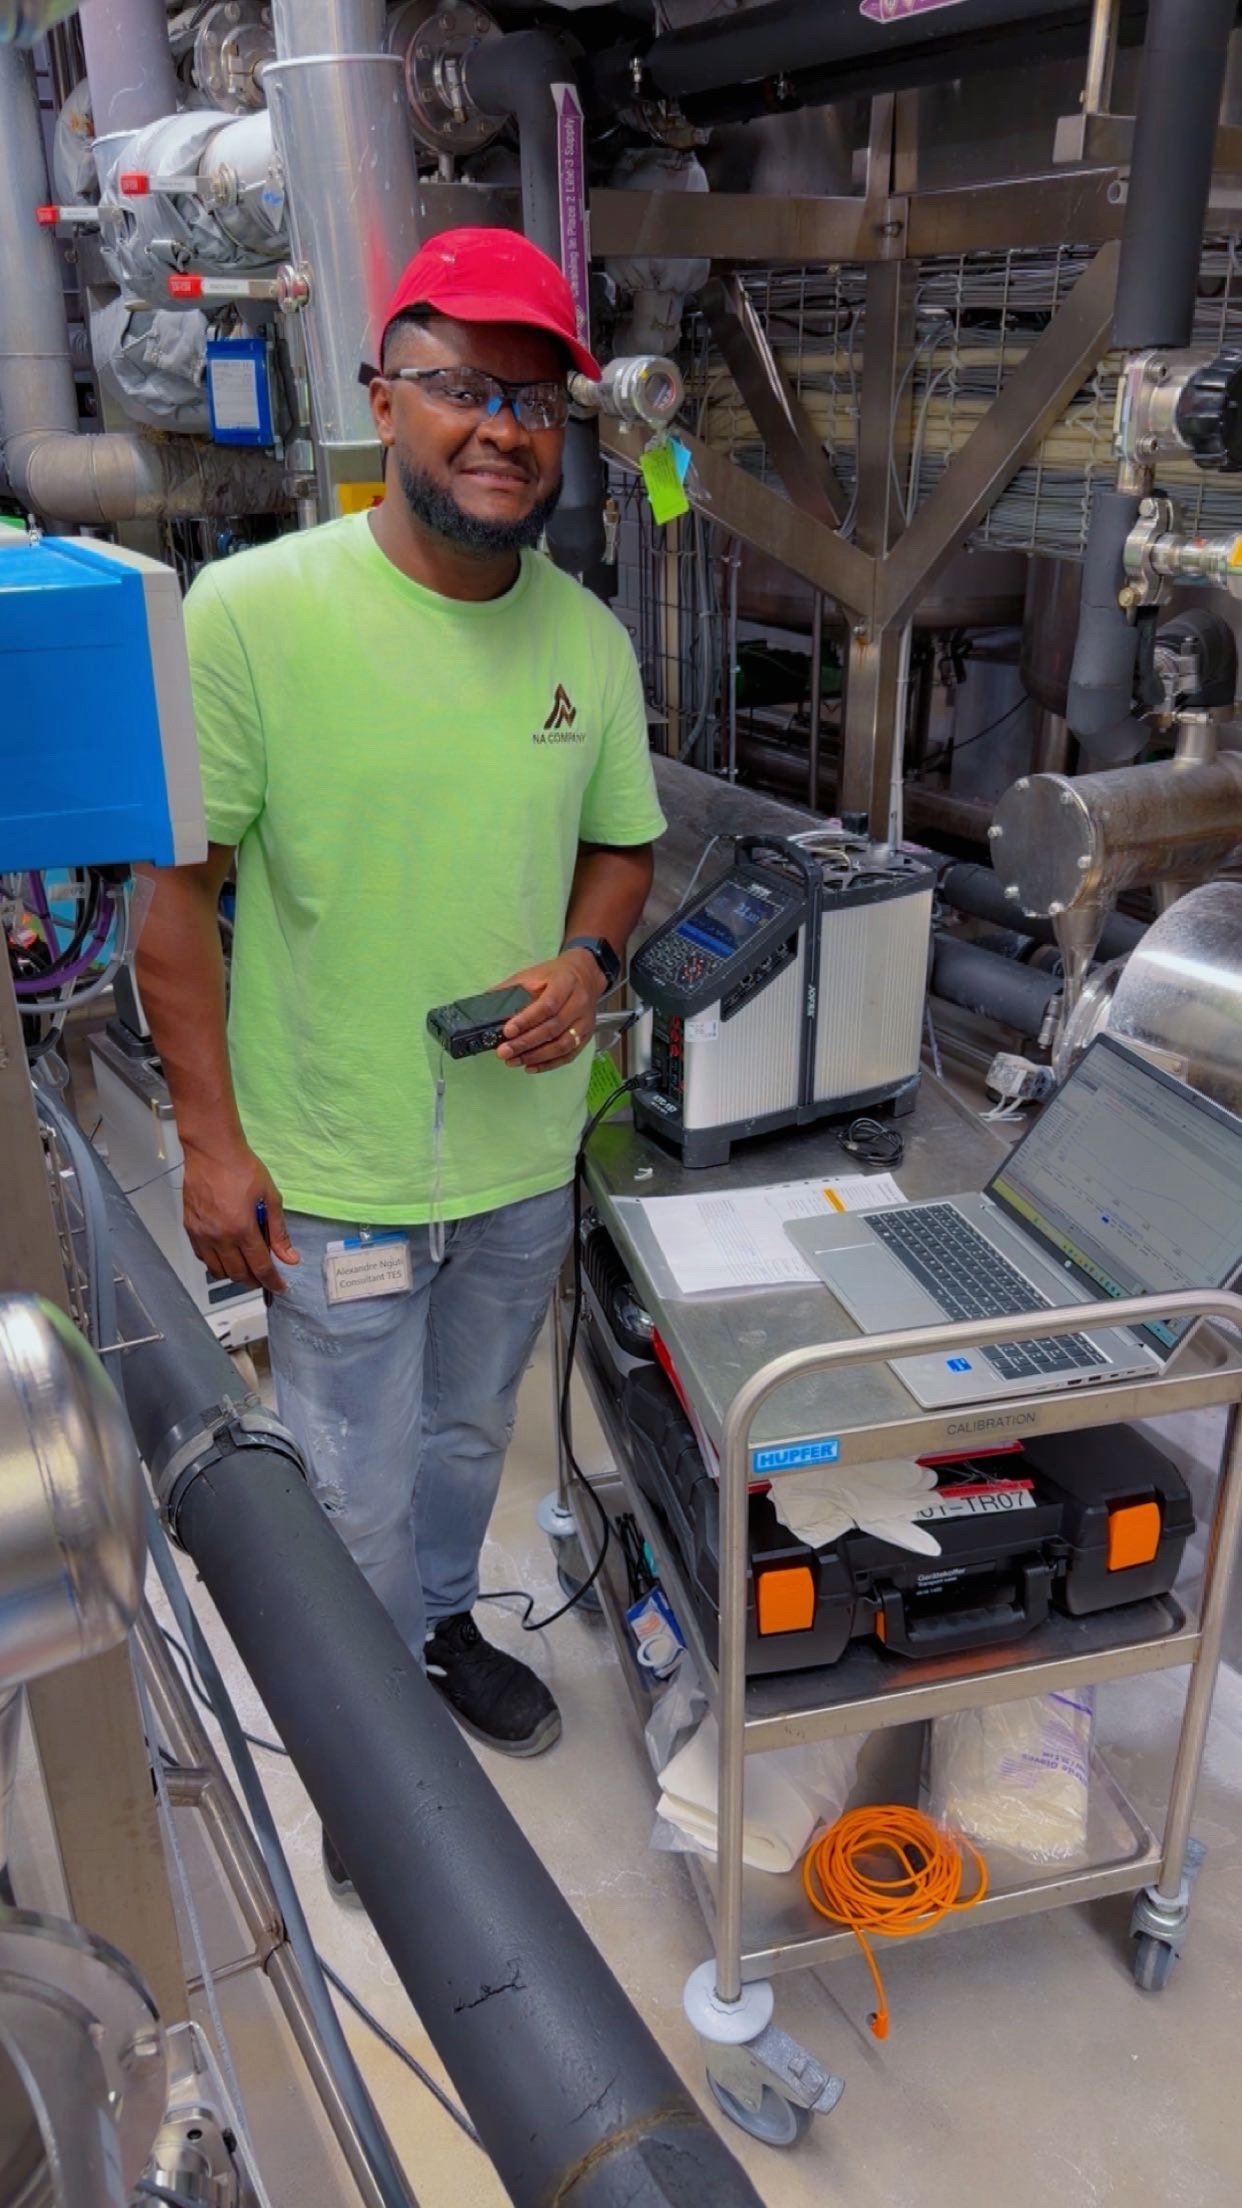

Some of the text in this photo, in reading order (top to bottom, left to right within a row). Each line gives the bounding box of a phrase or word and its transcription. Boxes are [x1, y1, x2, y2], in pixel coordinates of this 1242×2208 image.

[564, 117, 575, 156] Supply
[532, 731, 586, 745] NA COMPANY
[339, 1273, 385, 1289] Consultant
[946, 1412, 1036, 1435] CALIBRATION
[760, 1443, 834, 1467] HUPFER
